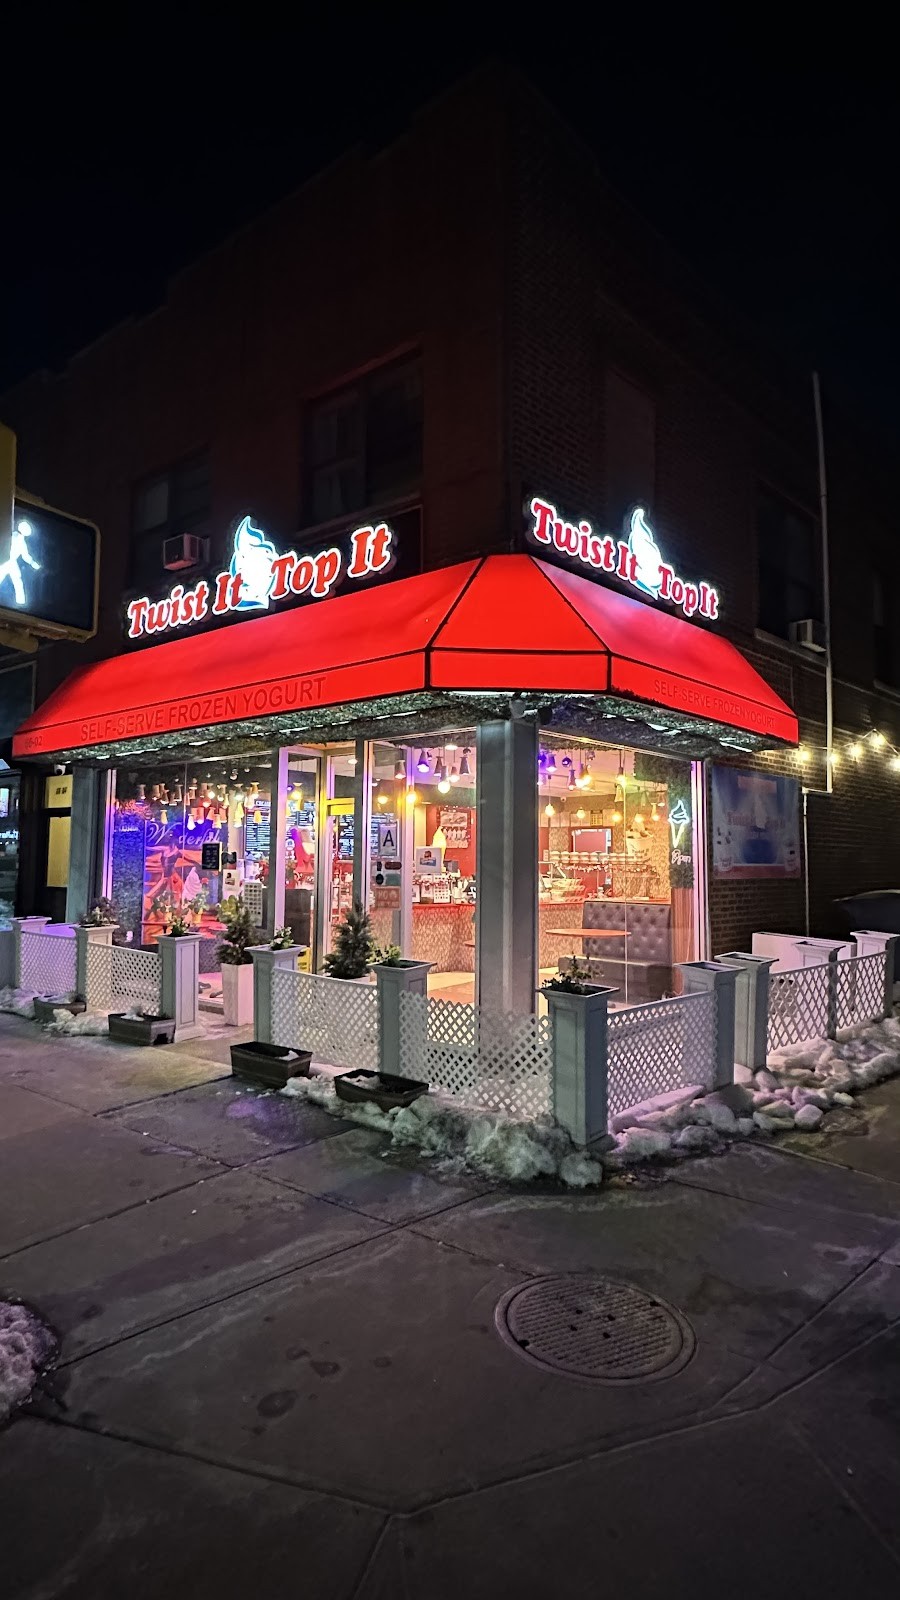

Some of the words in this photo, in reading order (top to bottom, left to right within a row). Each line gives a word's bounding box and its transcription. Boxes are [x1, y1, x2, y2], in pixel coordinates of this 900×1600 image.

[129, 582, 208, 637] Twist
[214, 572, 243, 613] It
[270, 549, 340, 598] Top
[348, 525, 391, 577] It
[529, 499, 616, 571] Twist
[617, 541, 640, 583] It
[657, 563, 699, 616] Top
[699, 581, 718, 618] It
[80, 709, 164, 742] SELF-SERVE
[168, 695, 237, 726] FROZEN
[241, 677, 327, 713] YOGURT
[653, 679, 711, 709] SELF-SERVE
[713, 698, 745, 718] FROZEN
[744, 708, 776, 728] YOGURT
[382, 829, 395, 848] A
[671, 848, 692, 866] Open
